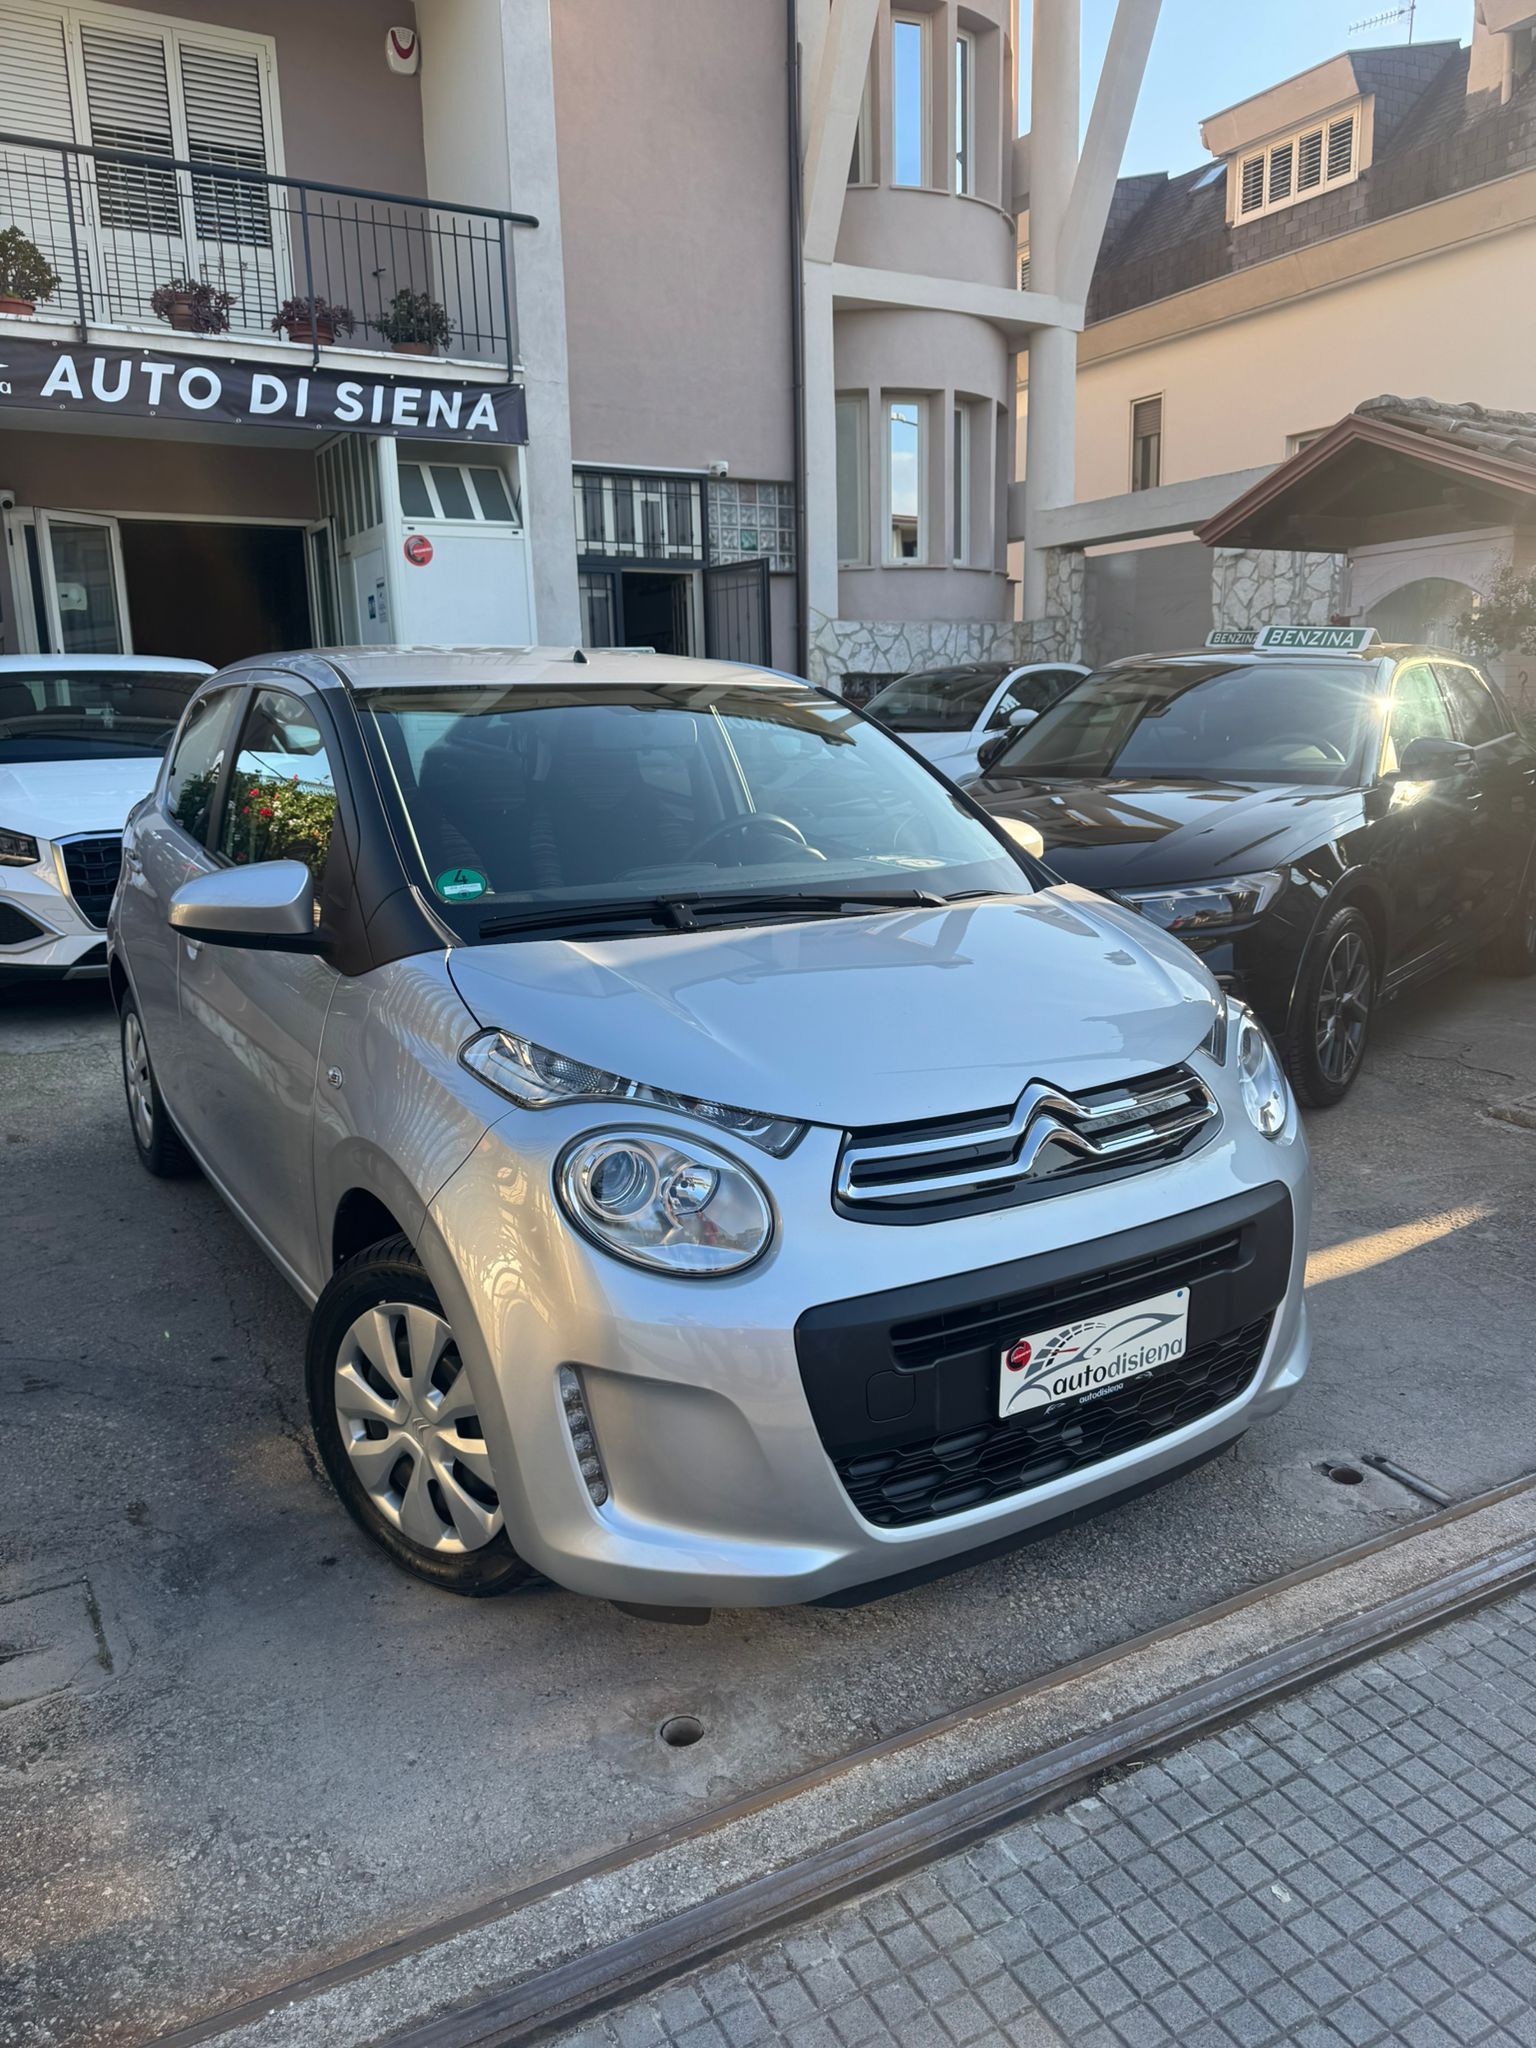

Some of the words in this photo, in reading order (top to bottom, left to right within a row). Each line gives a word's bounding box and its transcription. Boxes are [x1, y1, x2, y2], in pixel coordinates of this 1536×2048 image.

[40, 354, 222, 410] AUTO
[248, 373, 310, 418] DI
[333, 381, 500, 433] SIENA
[1268, 629, 1355, 647] BENZINA
[453, 869, 469, 885] 4
[1052, 1337, 1184, 1397] autodisiena
[1078, 1381, 1125, 1405] autodisiena
